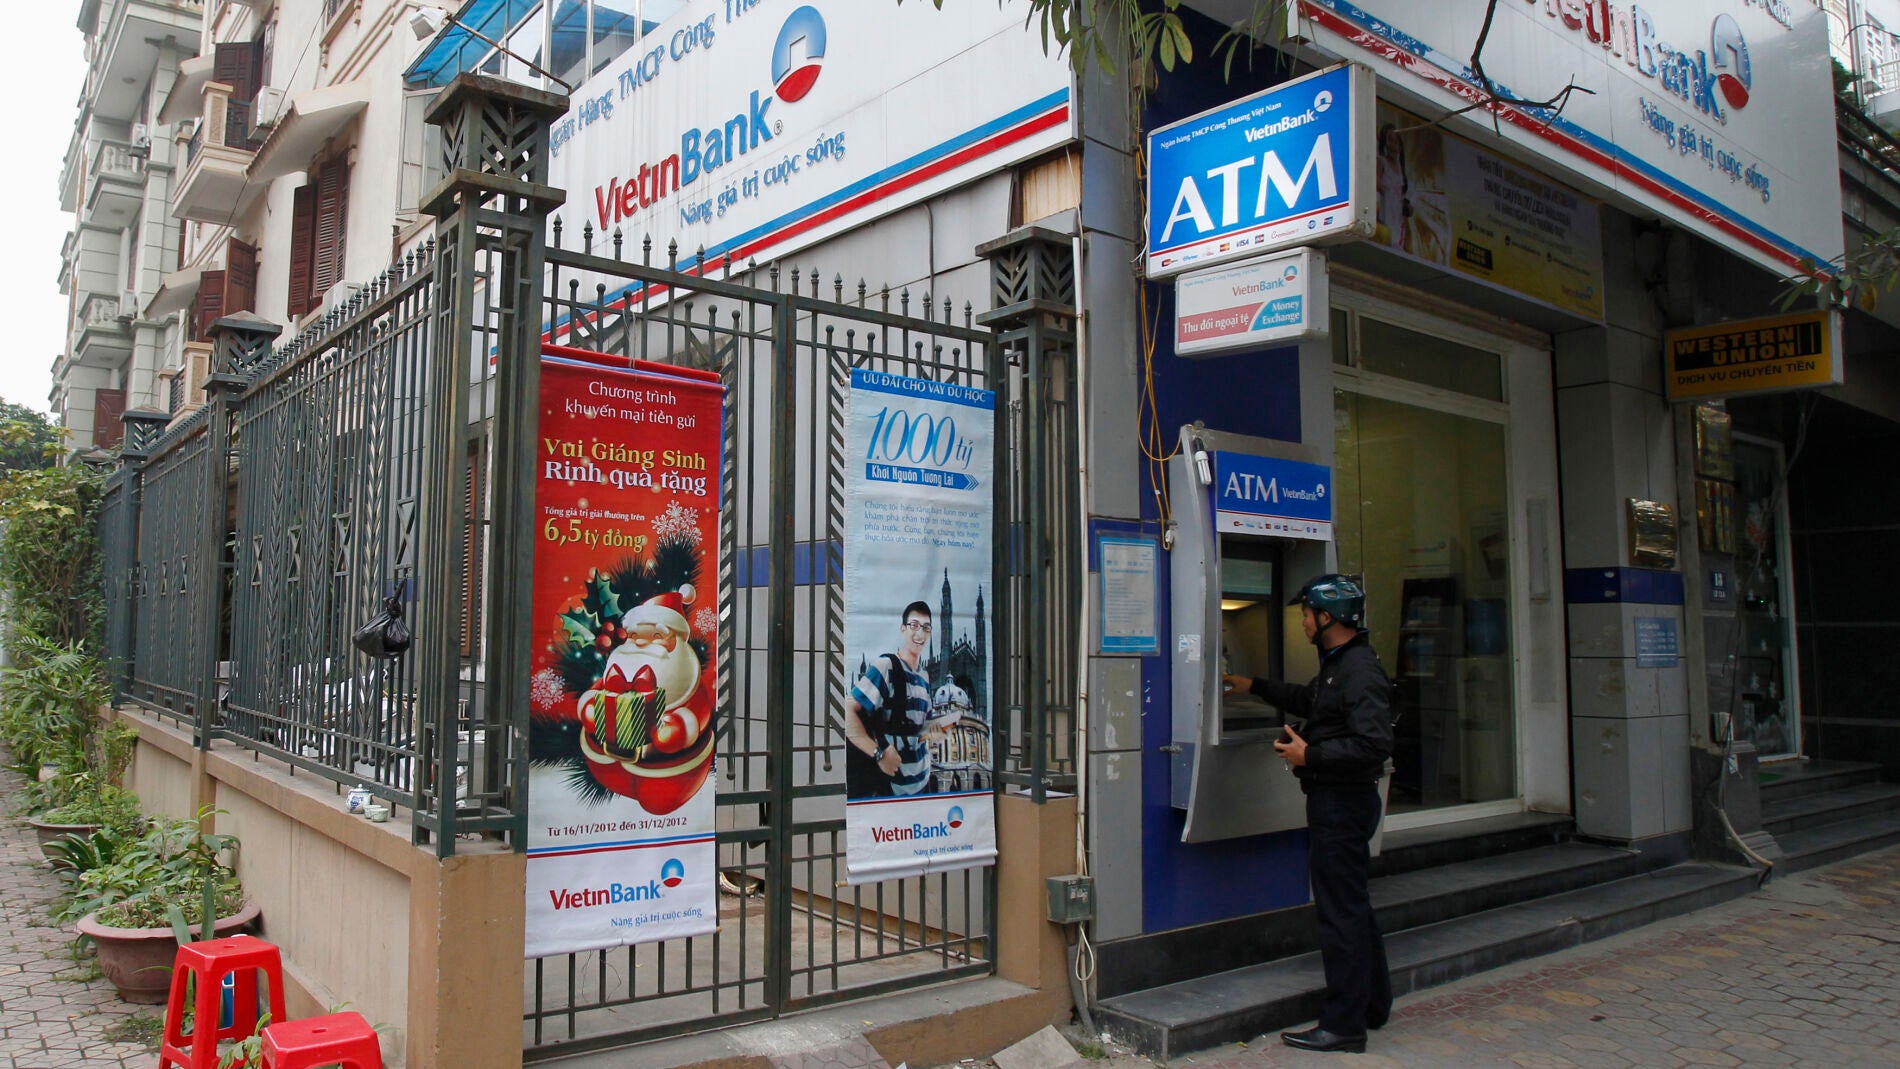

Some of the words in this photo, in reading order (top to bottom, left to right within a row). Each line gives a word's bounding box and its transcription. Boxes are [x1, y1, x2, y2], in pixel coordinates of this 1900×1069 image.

[549, 118, 574, 158] gân
[578, 88, 613, 130] Hàng
[618, 44, 665, 100] TMCP
[670, 13, 716, 61] Công
[1265, 102, 1282, 112] Nam
[1244, 109, 1315, 143] VietinBank
[595, 90, 773, 231] VietinBank
[1640, 97, 1675, 149] Nâng
[1679, 124, 1697, 156] giá
[1700, 135, 1714, 170] trị
[1717, 150, 1742, 183] cuộc
[1745, 163, 1769, 203] sống
[680, 198, 713, 227] Nâng
[717, 181, 738, 216] giá
[742, 170, 758, 197] trị
[763, 154, 800, 183] cuộc
[806, 131, 845, 166] sống
[1160, 132, 1337, 243] ATM
[1232, 278, 1284, 296] VietinBank
[1262, 312, 1300, 325] Exchange
[1272, 301, 1299, 312] Money
[1183, 322, 1198, 333] Thu
[1215, 314, 1238, 330] ngoại
[1240, 314, 1249, 325] tệ
[1676, 326, 1794, 355] WESTERN
[1713, 342, 1794, 365] UNION
[589, 381, 642, 404] Chương
[646, 390, 676, 405] trình
[902, 379, 926, 392] CHO
[928, 382, 945, 395] VAY
[948, 386, 962, 398] DU
[965, 391, 986, 403] HỌC
[565, 398, 616, 419] khuyến
[620, 408, 645, 424] mại
[649, 409, 673, 424] tiền
[677, 415, 696, 429] gửi
[543, 437, 583, 458] Vui
[591, 442, 655, 468] Giáng
[662, 449, 706, 470] Sinh
[544, 460, 602, 482] Rinh
[609, 466, 652, 489] quà
[660, 469, 706, 497] tặng
[943, 473, 954, 486] Lai
[1224, 471, 1279, 504] ATM
[1282, 487, 1317, 501] VietinBank
[544, 506, 563, 517] Tổng
[565, 507, 577, 518] giá
[579, 509, 588, 518] trị
[630, 513, 645, 521] trên
[544, 517, 582, 546] 6,5
[584, 529, 600, 550] tỷ
[603, 528, 643, 553] đồng
[547, 825, 560, 837] Từ
[563, 822, 617, 836] 16/11/2012
[619, 820, 636, 831] đến
[638, 817, 687, 830] 31/12/2012
[872, 821, 948, 843] VietinBank
[550, 880, 661, 910] VietinBank
[650, 912, 660, 924] trị
